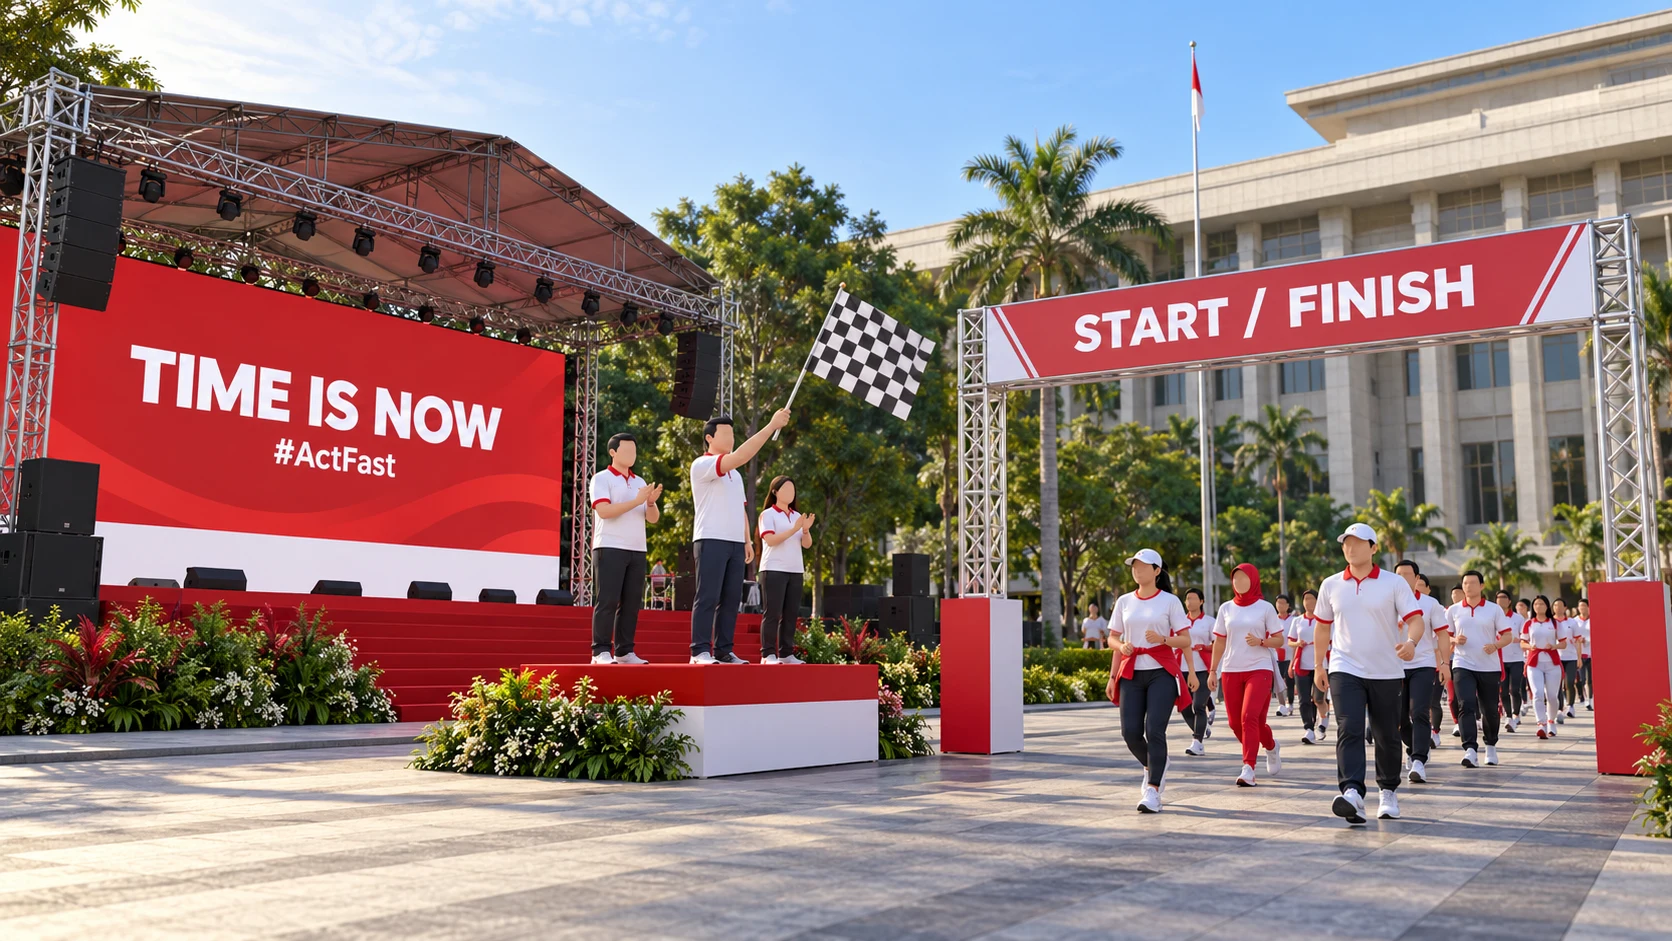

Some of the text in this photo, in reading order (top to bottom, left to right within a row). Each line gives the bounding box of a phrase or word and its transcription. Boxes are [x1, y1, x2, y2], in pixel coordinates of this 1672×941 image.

[1073, 264, 1475, 353] START / FINISH
[130, 344, 503, 451] TIME IS NOW
[273, 438, 396, 478] #ActFast
